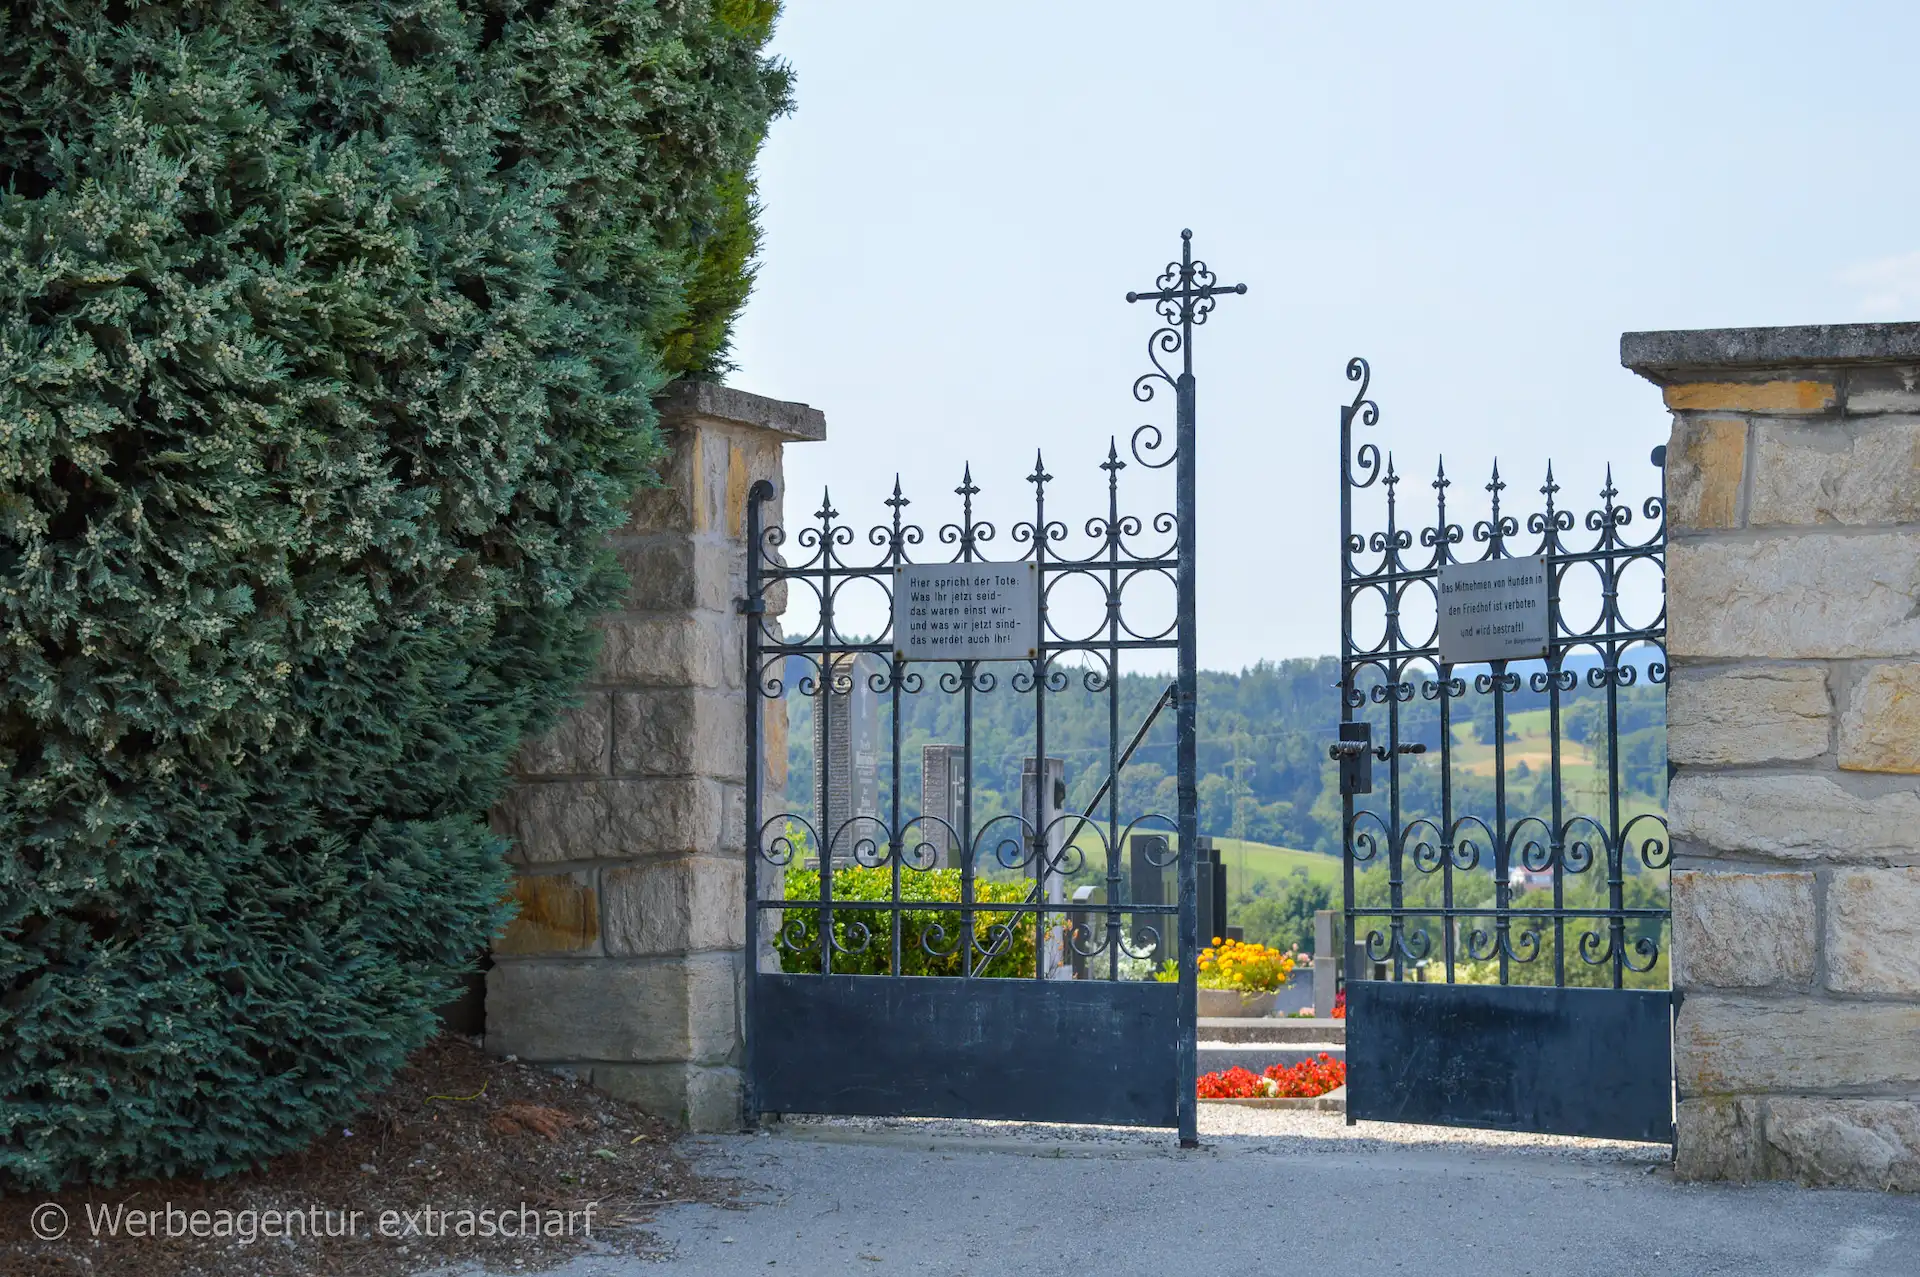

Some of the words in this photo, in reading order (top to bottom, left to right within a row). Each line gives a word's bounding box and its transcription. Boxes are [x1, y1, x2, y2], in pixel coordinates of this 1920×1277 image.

[910, 578, 930, 587] Hier
[935, 577, 969, 589] spricht
[974, 577, 990, 586] der
[1442, 582, 1453, 593] Das
[1455, 580, 1491, 592] Mitnehmen
[1494, 579, 1505, 588] von
[1508, 575, 1533, 586] Hunden
[1536, 573, 1542, 584] in
[911, 593, 930, 602] Was
[934, 592, 947, 600] Ihr
[952, 593, 972, 603] jetzt
[911, 607, 926, 615] das
[931, 607, 959, 615] waren
[964, 606, 986, 614] einst
[1449, 606, 1461, 615] den
[1463, 601, 1491, 614] Friedhof
[1493, 600, 1502, 610] ist
[1505, 598, 1536, 609] verboten
[911, 622, 926, 630] und
[953, 621, 968, 629] wir
[972, 621, 992, 631] jetzt
[1461, 626, 1472, 637] und
[1476, 624, 1490, 635] wird
[1493, 622, 1524, 634] bestraft!
[911, 636, 926, 645] das
[931, 635, 963, 644] werdet
[968, 635, 990, 643] auch
[994, 635, 1011, 643] Ihr!
